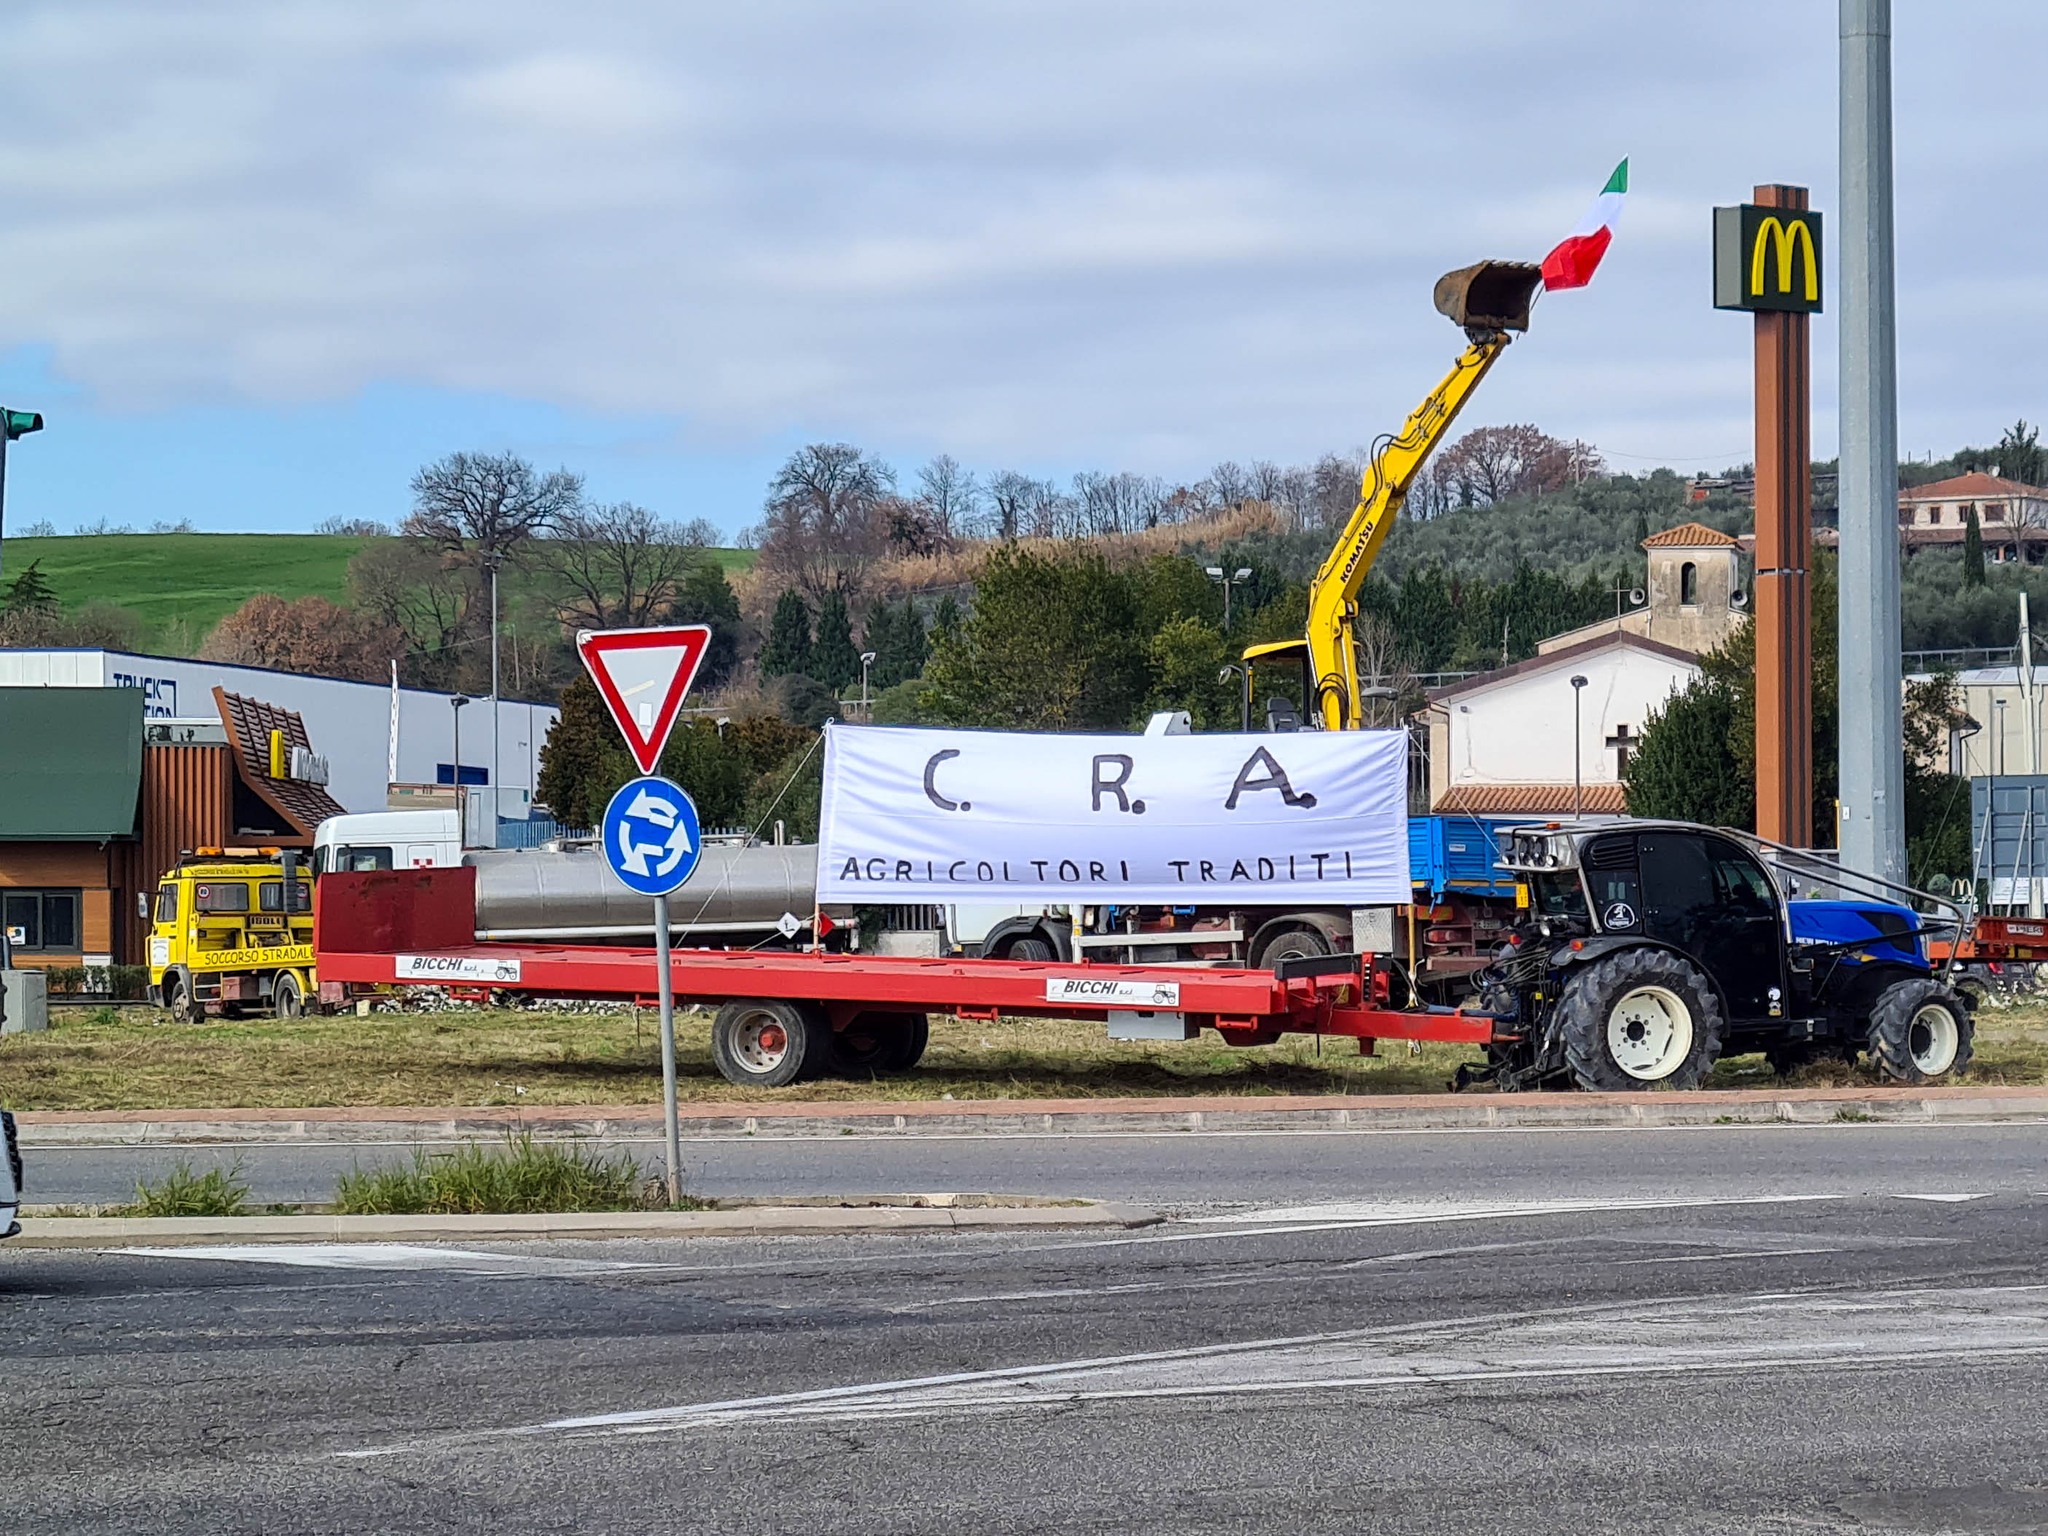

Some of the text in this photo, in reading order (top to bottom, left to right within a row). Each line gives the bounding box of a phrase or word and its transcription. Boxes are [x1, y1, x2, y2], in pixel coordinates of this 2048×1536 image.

[1340, 521, 1374, 583] KOMATSU
[113, 673, 162, 700] TRUCK
[923, 745, 1318, 815] C. R. A.
[839, 851, 1353, 882] AGRICOLTORI TRADITI
[205, 950, 259, 965] SOCCORSO
[411, 957, 464, 971] BICCHI
[1063, 980, 1119, 995] BICCHI
